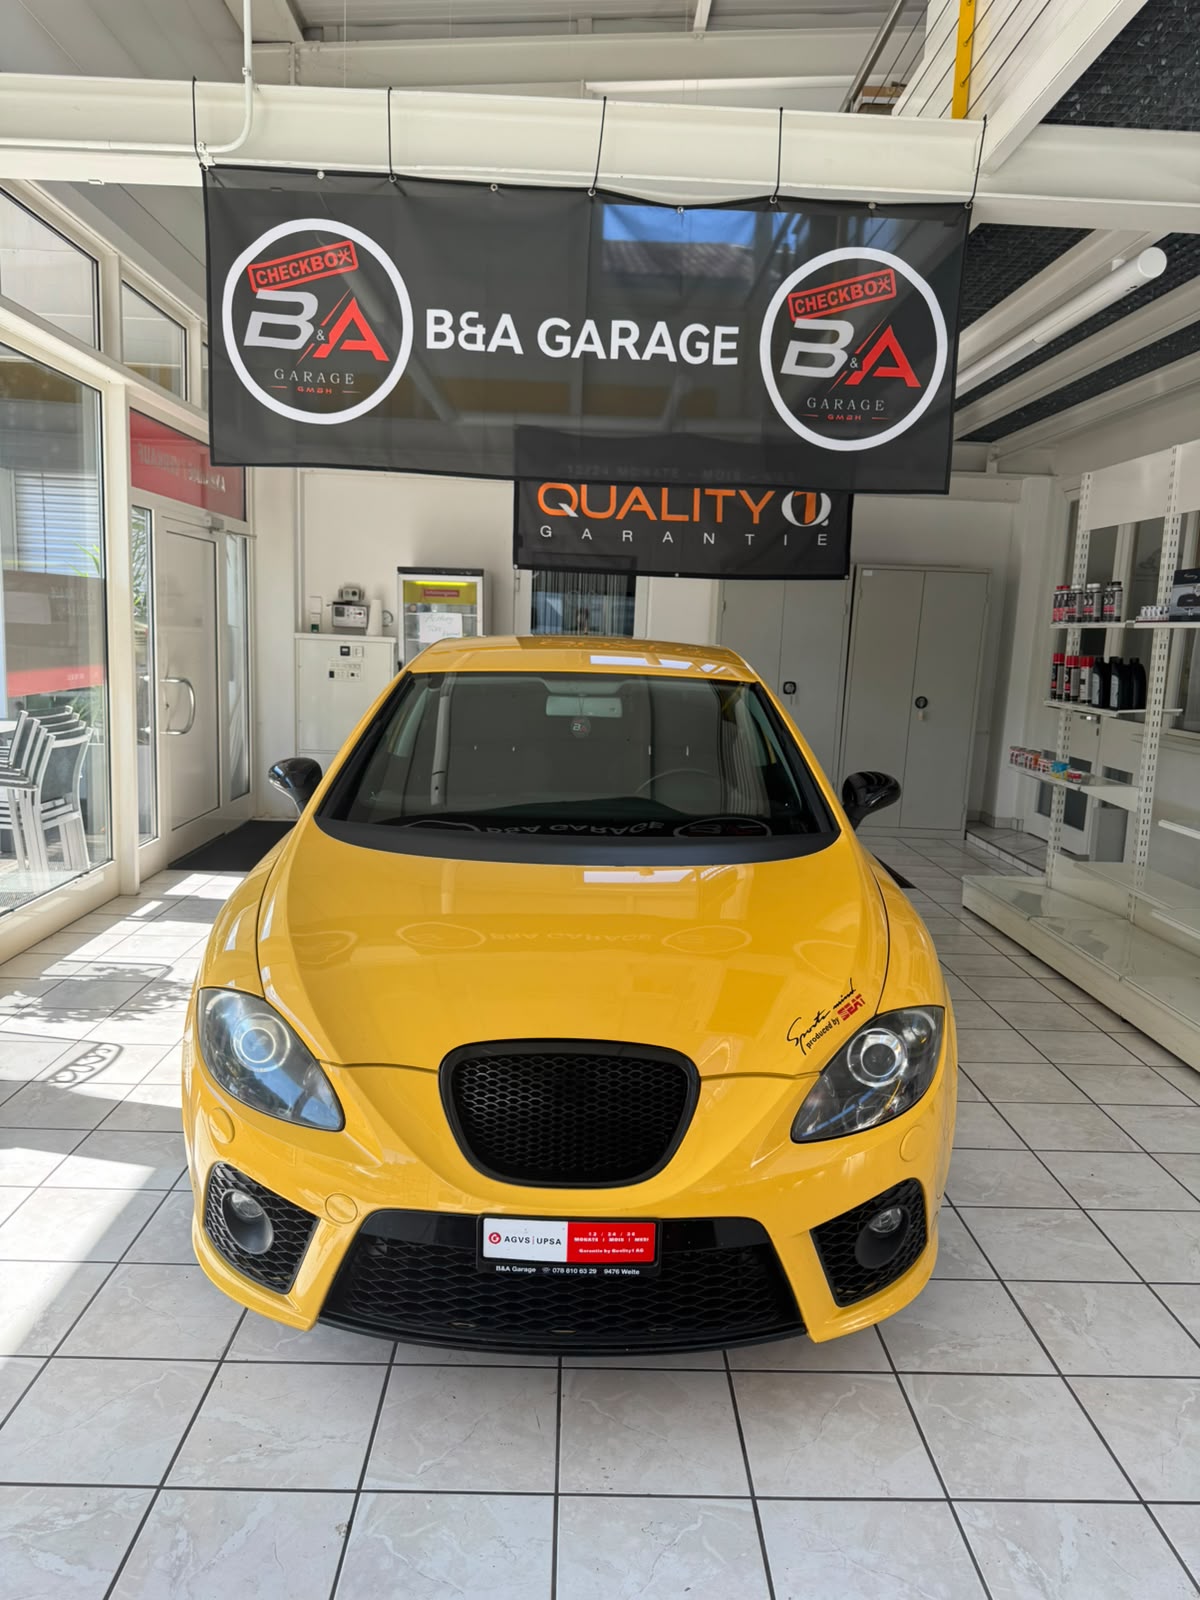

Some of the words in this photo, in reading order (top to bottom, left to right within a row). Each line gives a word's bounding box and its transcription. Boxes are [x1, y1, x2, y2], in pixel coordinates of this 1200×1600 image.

[255, 247, 353, 286] CHECKBOX
[794, 275, 892, 315] CHECKBOX
[425, 308, 524, 355] B&A
[536, 317, 740, 366] GARAGE
[273, 368, 355, 385] GARAGE
[806, 396, 886, 412] GARAGE
[537, 482, 776, 525] QUALITY
[540, 525, 828, 547] GARANTIE
[806, 1021, 833, 1049] produced
[837, 993, 866, 1021] SEAT
[504, 1235, 531, 1244] AGVS
[536, 1236, 562, 1245] UPSA
